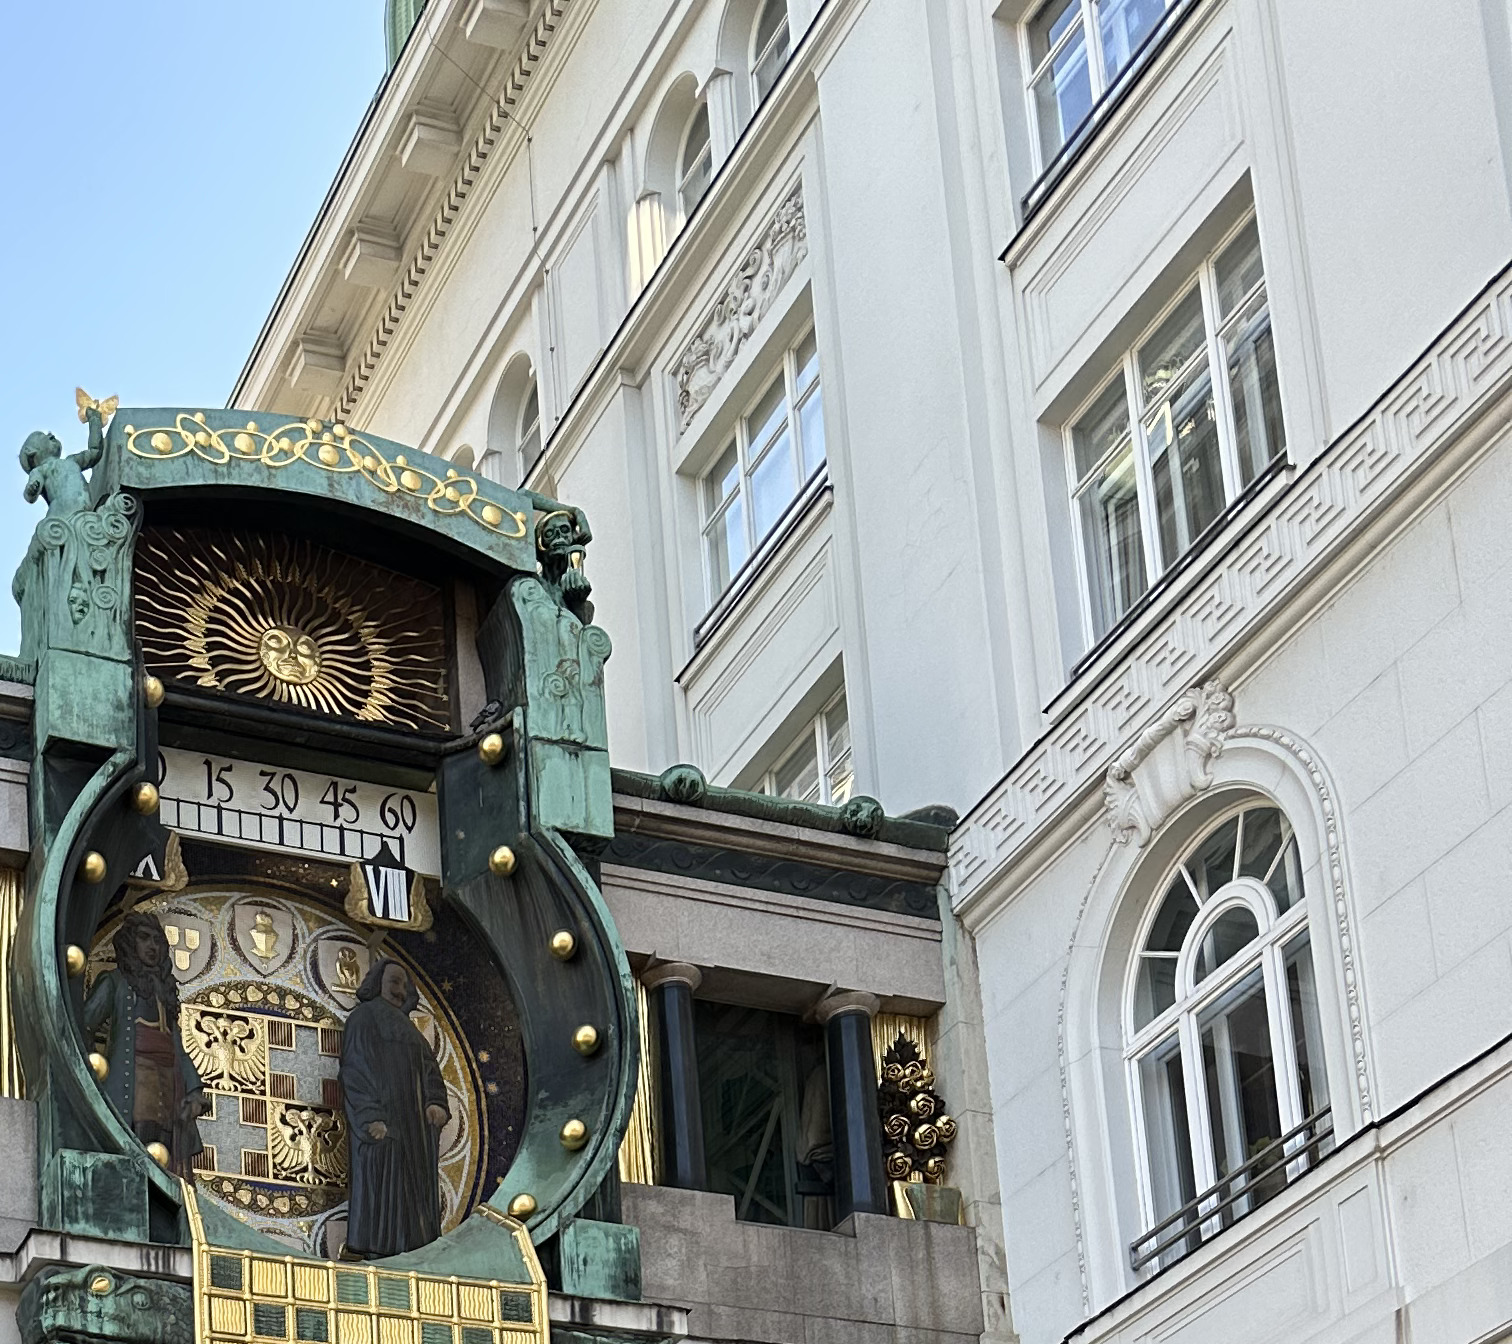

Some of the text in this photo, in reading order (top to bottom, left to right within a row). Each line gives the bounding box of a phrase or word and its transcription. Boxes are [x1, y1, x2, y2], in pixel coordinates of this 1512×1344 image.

[203, 757, 234, 802] 15
[259, 770, 299, 814] 30
[319, 780, 360, 824] 45
[379, 792, 416, 833] 60
[364, 864, 409, 922] VIII
